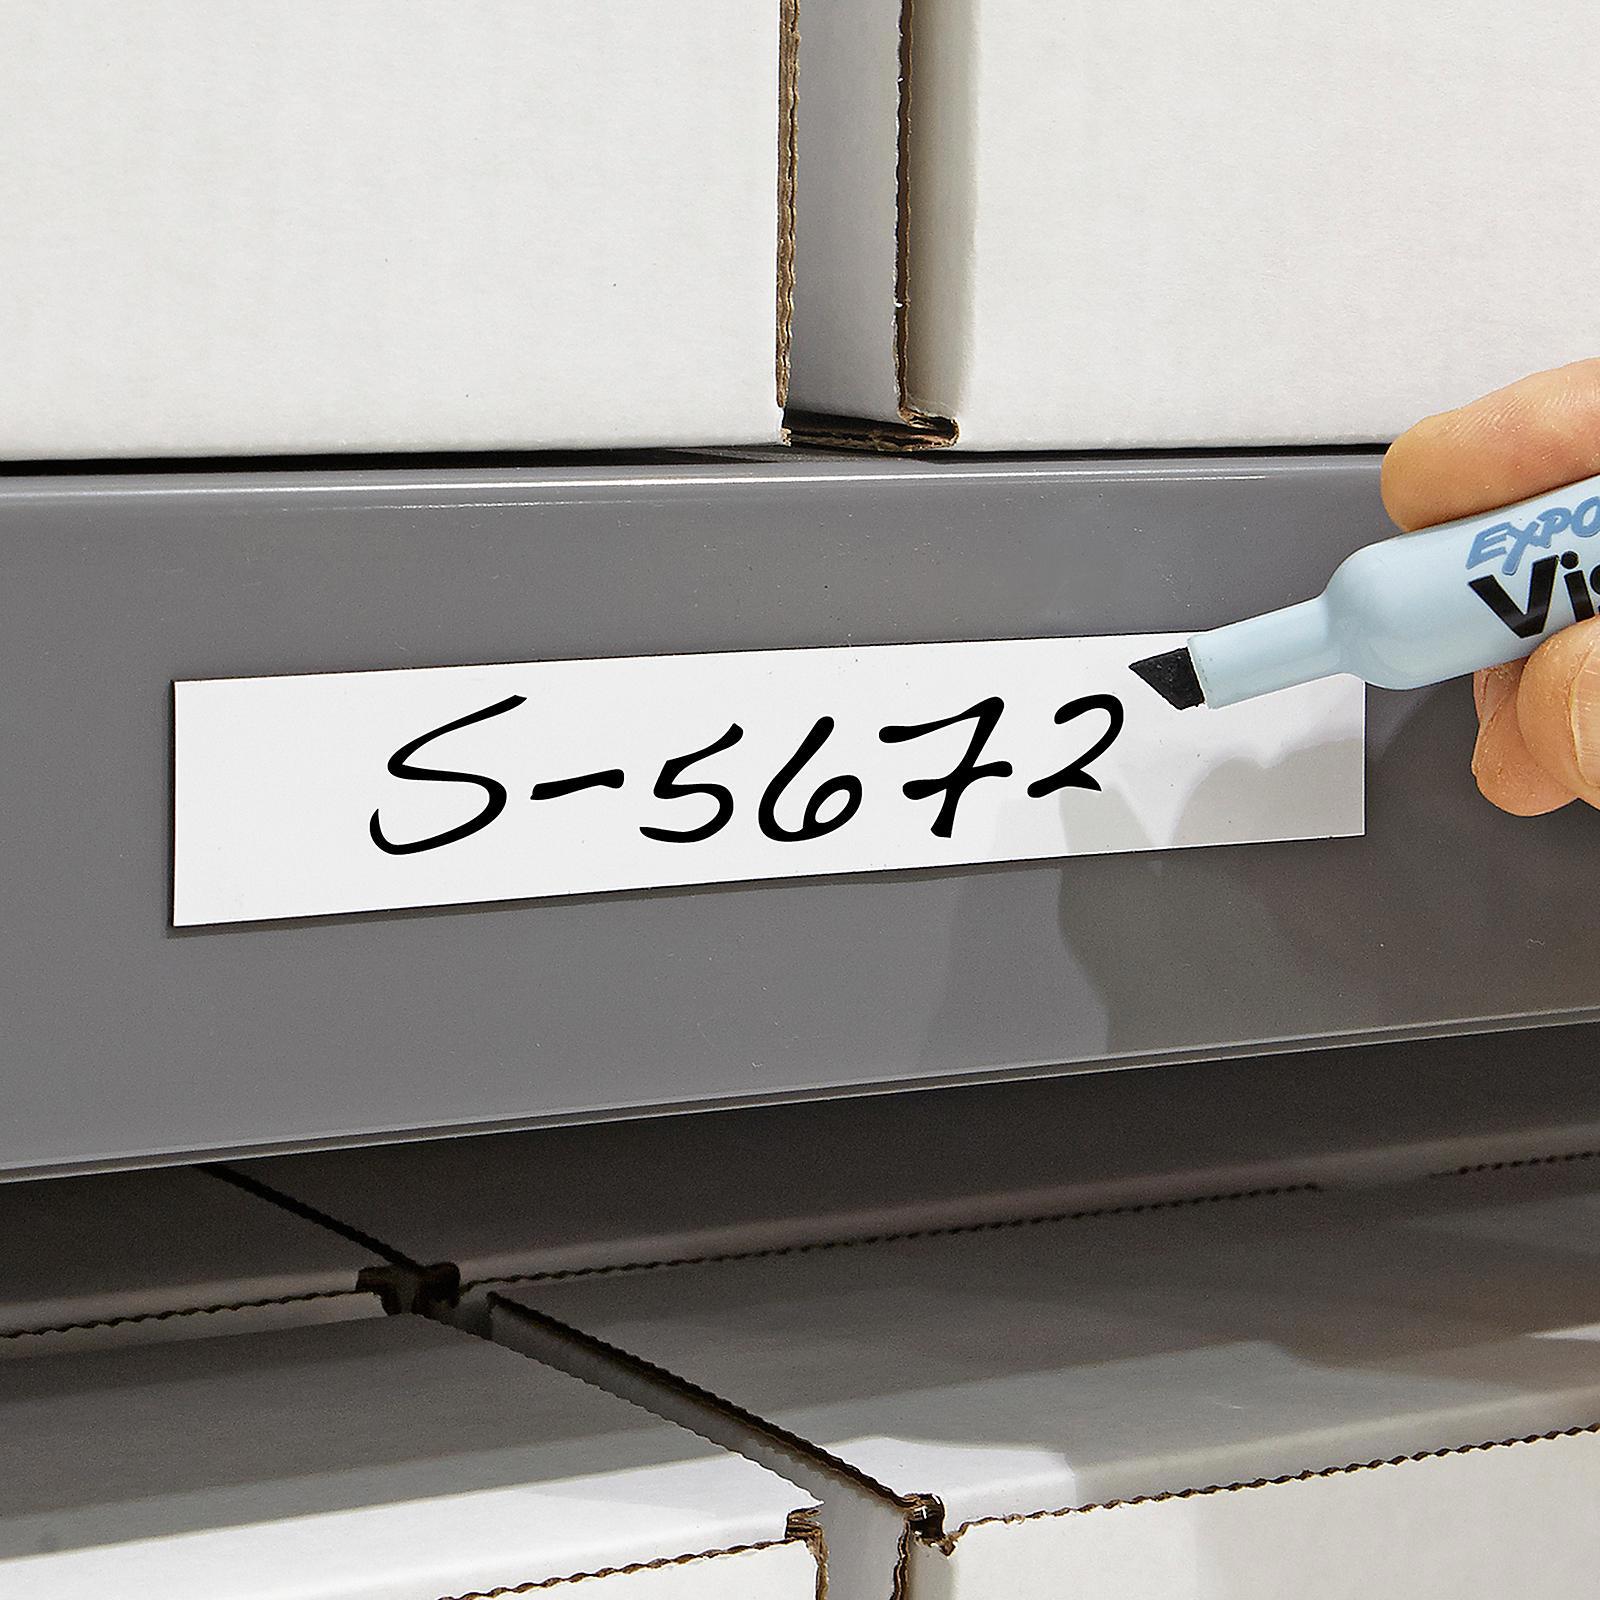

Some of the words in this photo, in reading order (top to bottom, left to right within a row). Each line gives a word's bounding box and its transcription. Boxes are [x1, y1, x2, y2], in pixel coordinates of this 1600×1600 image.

[1465, 496, 1600, 576] EXPO
[1468, 550, 1600, 639] Vi
[369, 693, 1125, 856] S-5672
